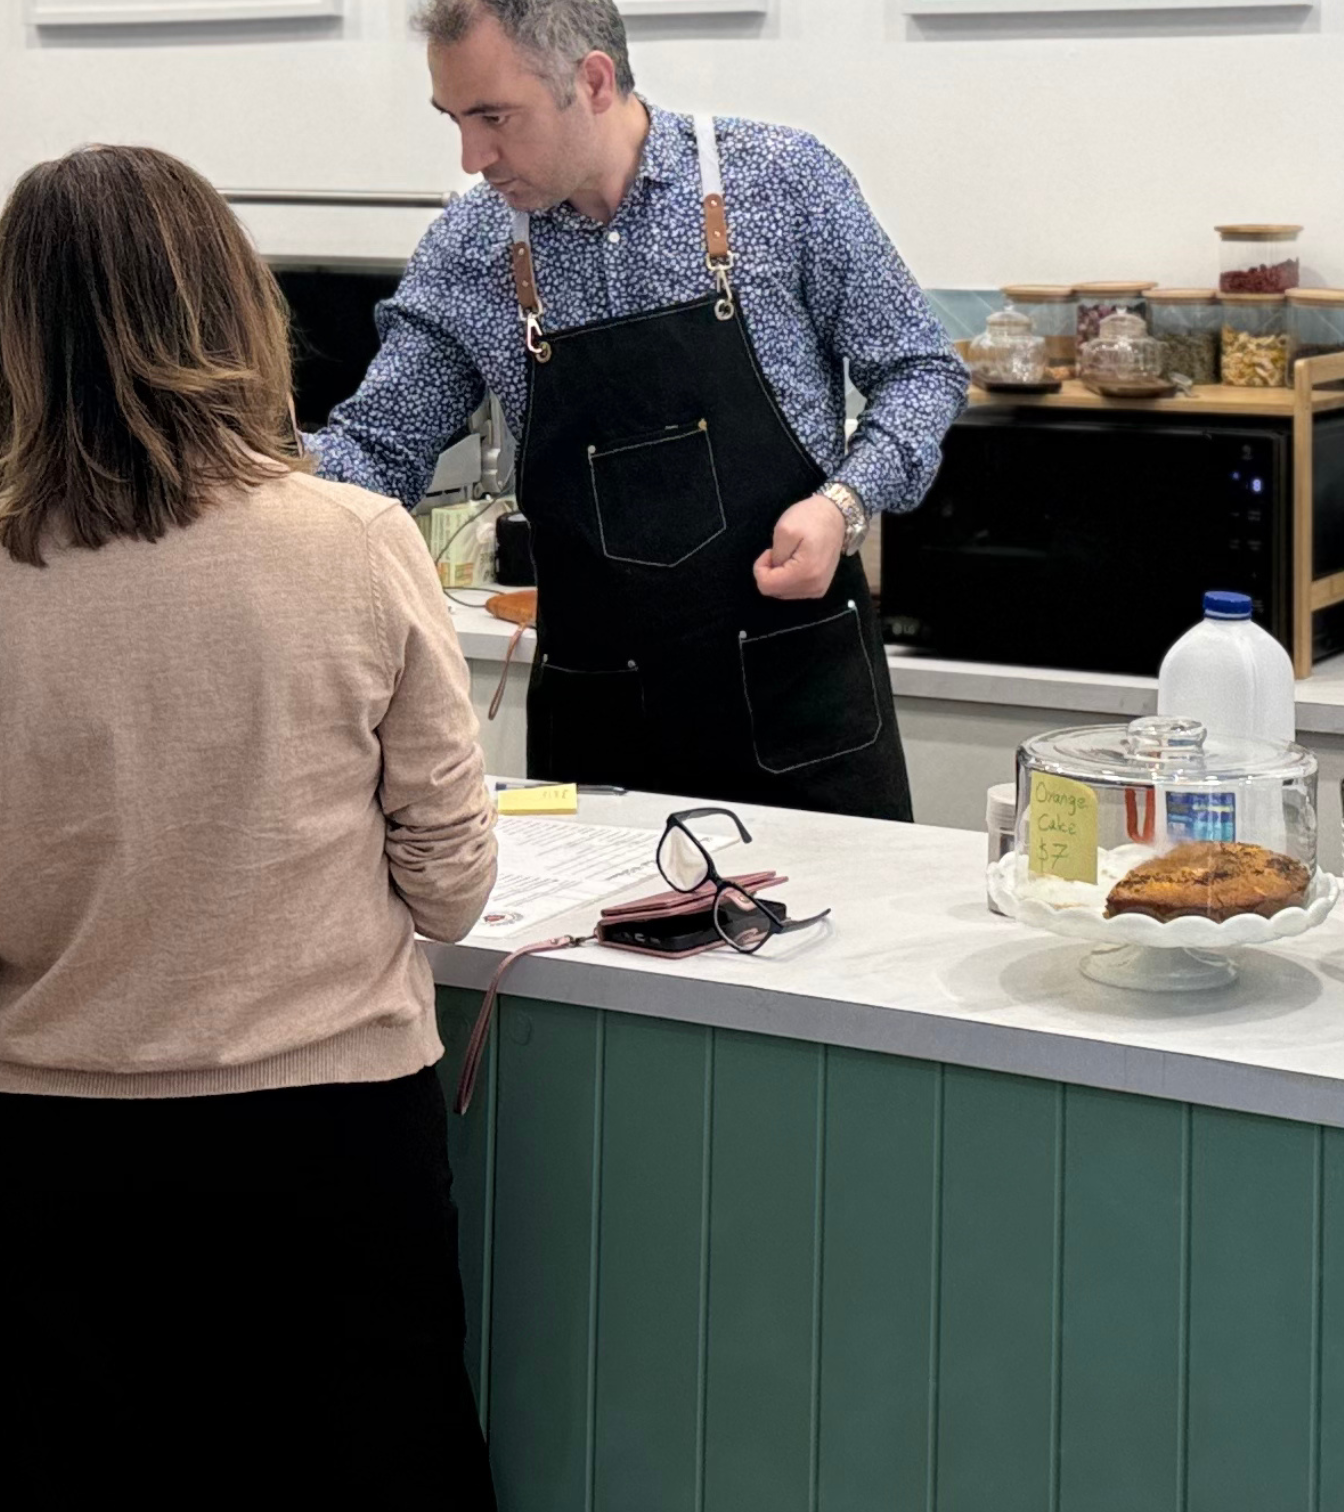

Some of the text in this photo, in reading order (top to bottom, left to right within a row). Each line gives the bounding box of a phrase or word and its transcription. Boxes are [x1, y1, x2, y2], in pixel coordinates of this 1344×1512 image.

[1036, 781, 1088, 816] Orange
[1038, 813, 1076, 834] Cake
[1039, 837, 1069, 873] $7
